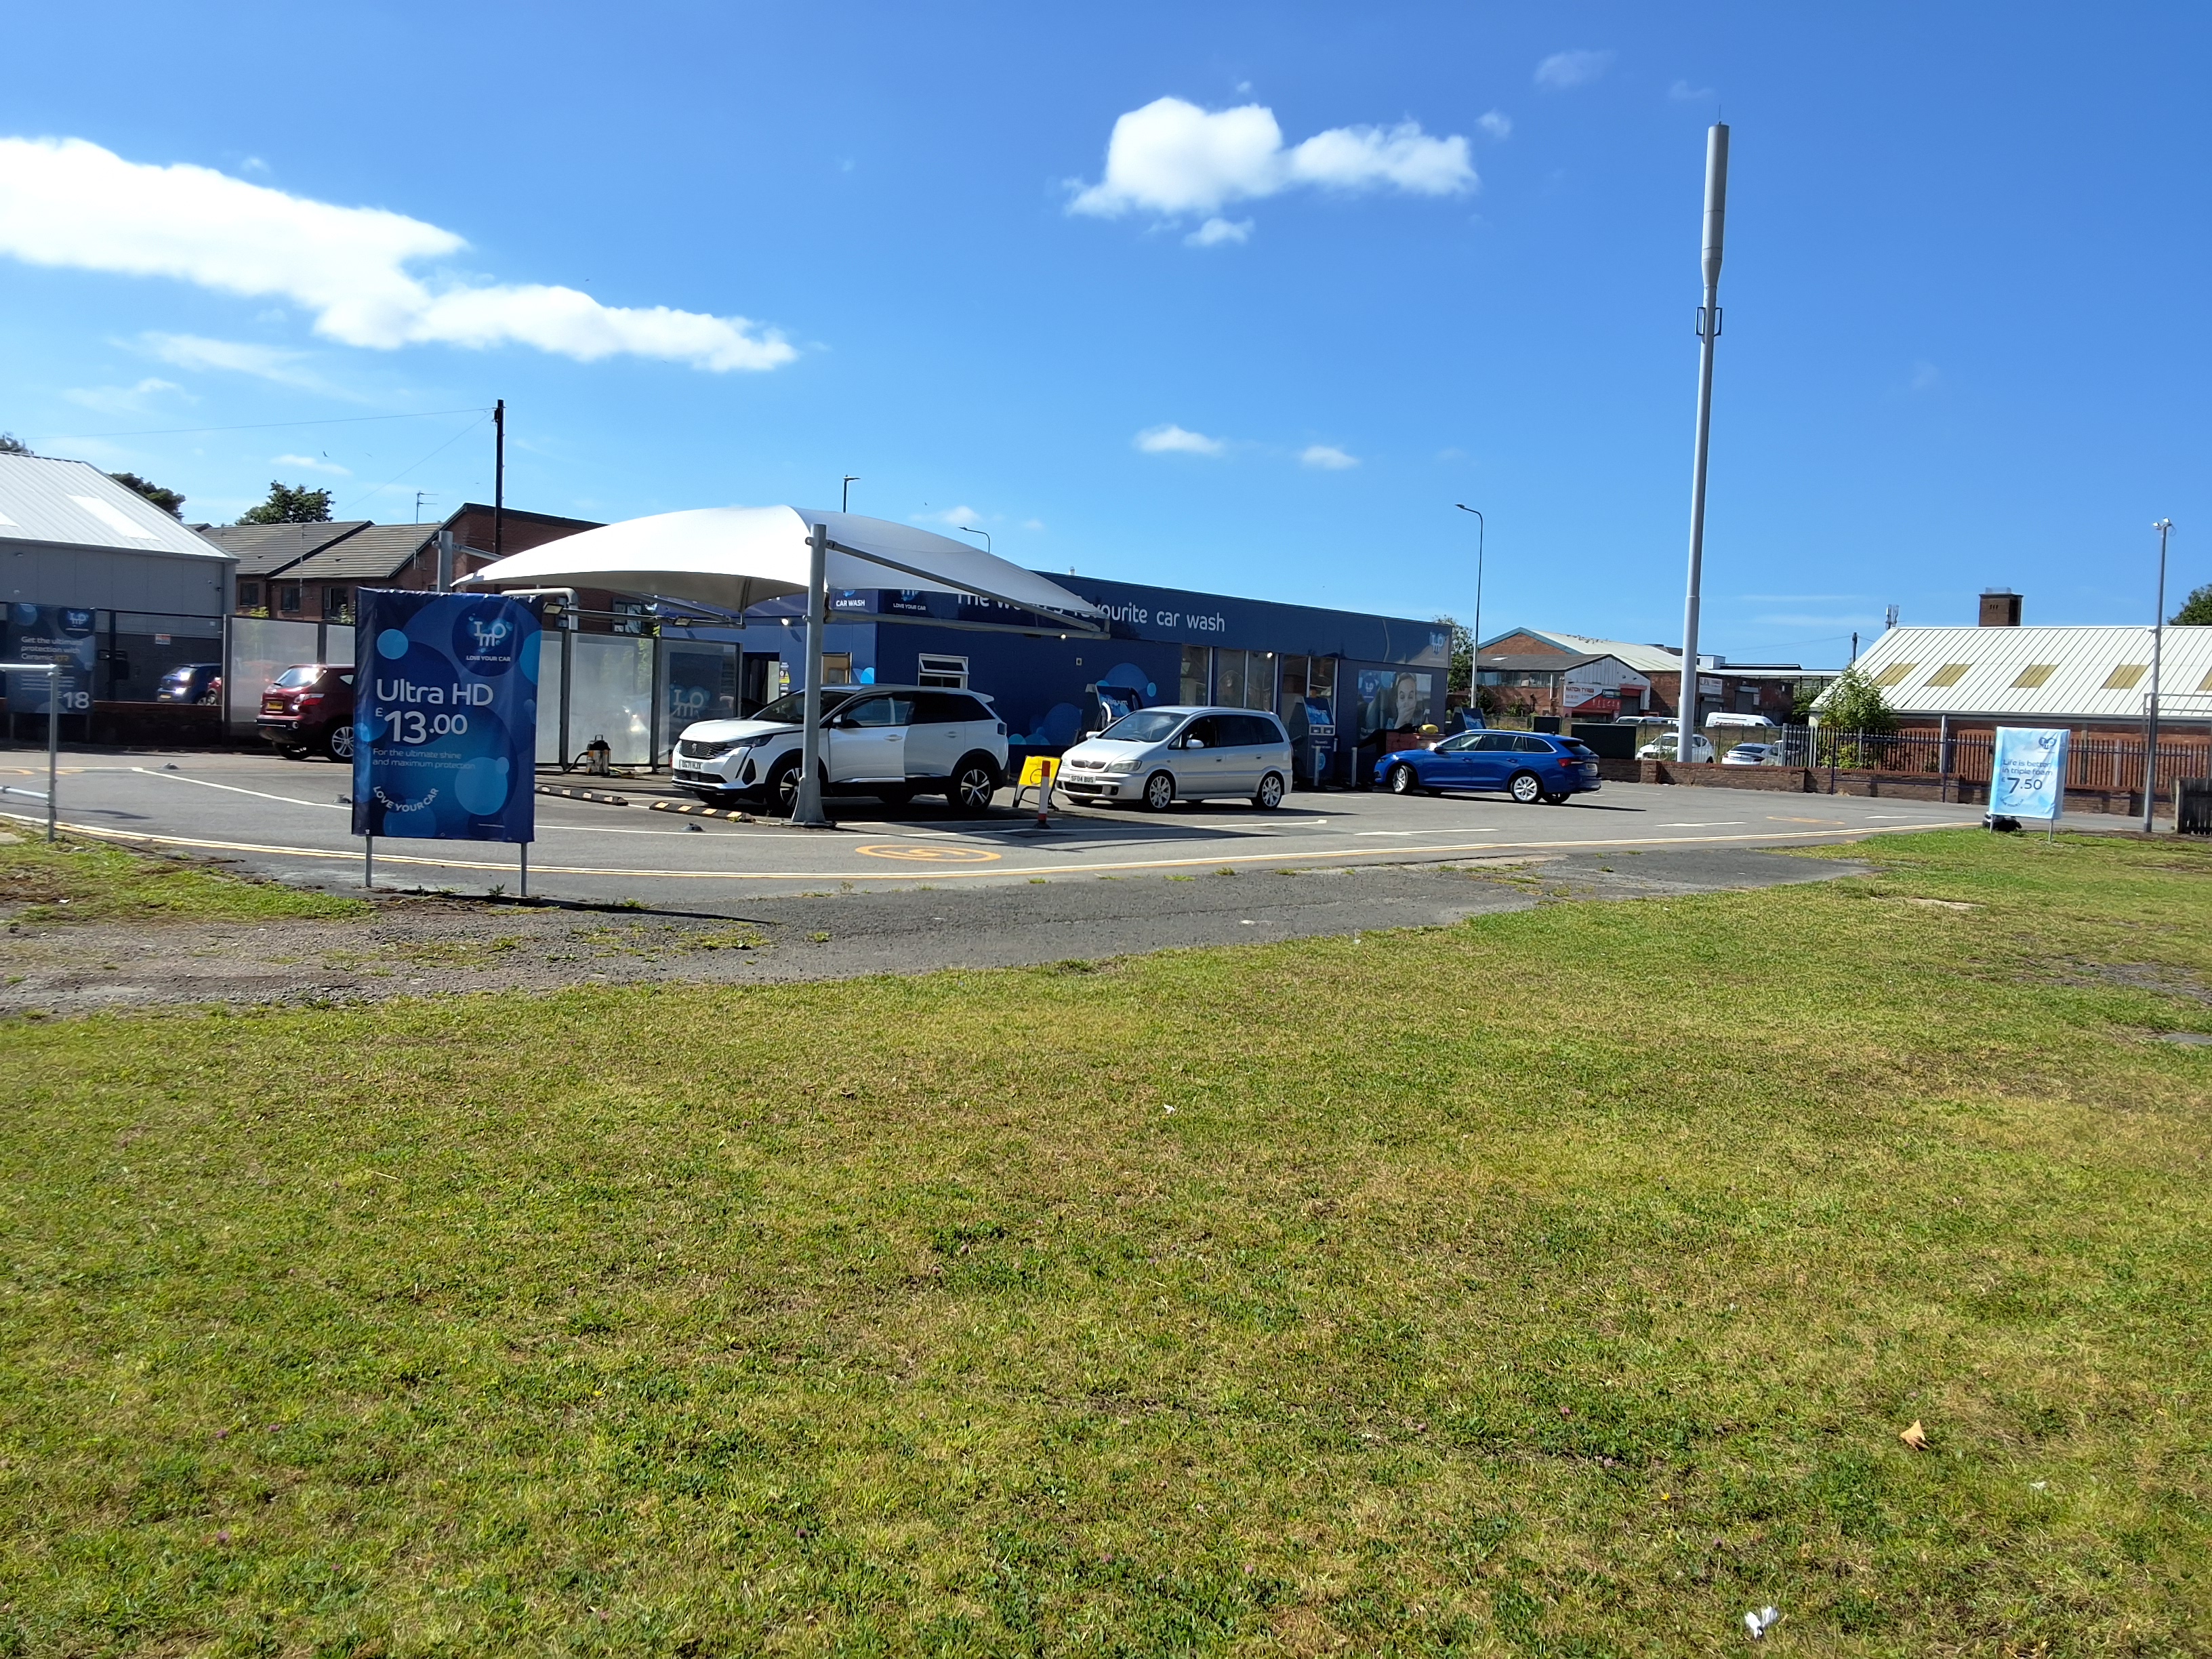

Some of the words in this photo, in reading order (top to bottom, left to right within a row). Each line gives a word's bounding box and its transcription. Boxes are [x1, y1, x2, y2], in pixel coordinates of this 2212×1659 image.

[848, 599, 865, 607] WASH
[1156, 611, 1180, 627] car
[1187, 612, 1225, 632] wash
[377, 678, 444, 704] Ultra
[452, 683, 493, 706] HD
[389, 749, 404, 757] the
[406, 750, 438, 758] ultimate
[2027, 760, 2051, 768] better
[2011, 767, 2030, 775] triple
[373, 786, 394, 808] LOVE
[394, 802, 424, 813] YOUR
[424, 787, 439, 806] CAR
